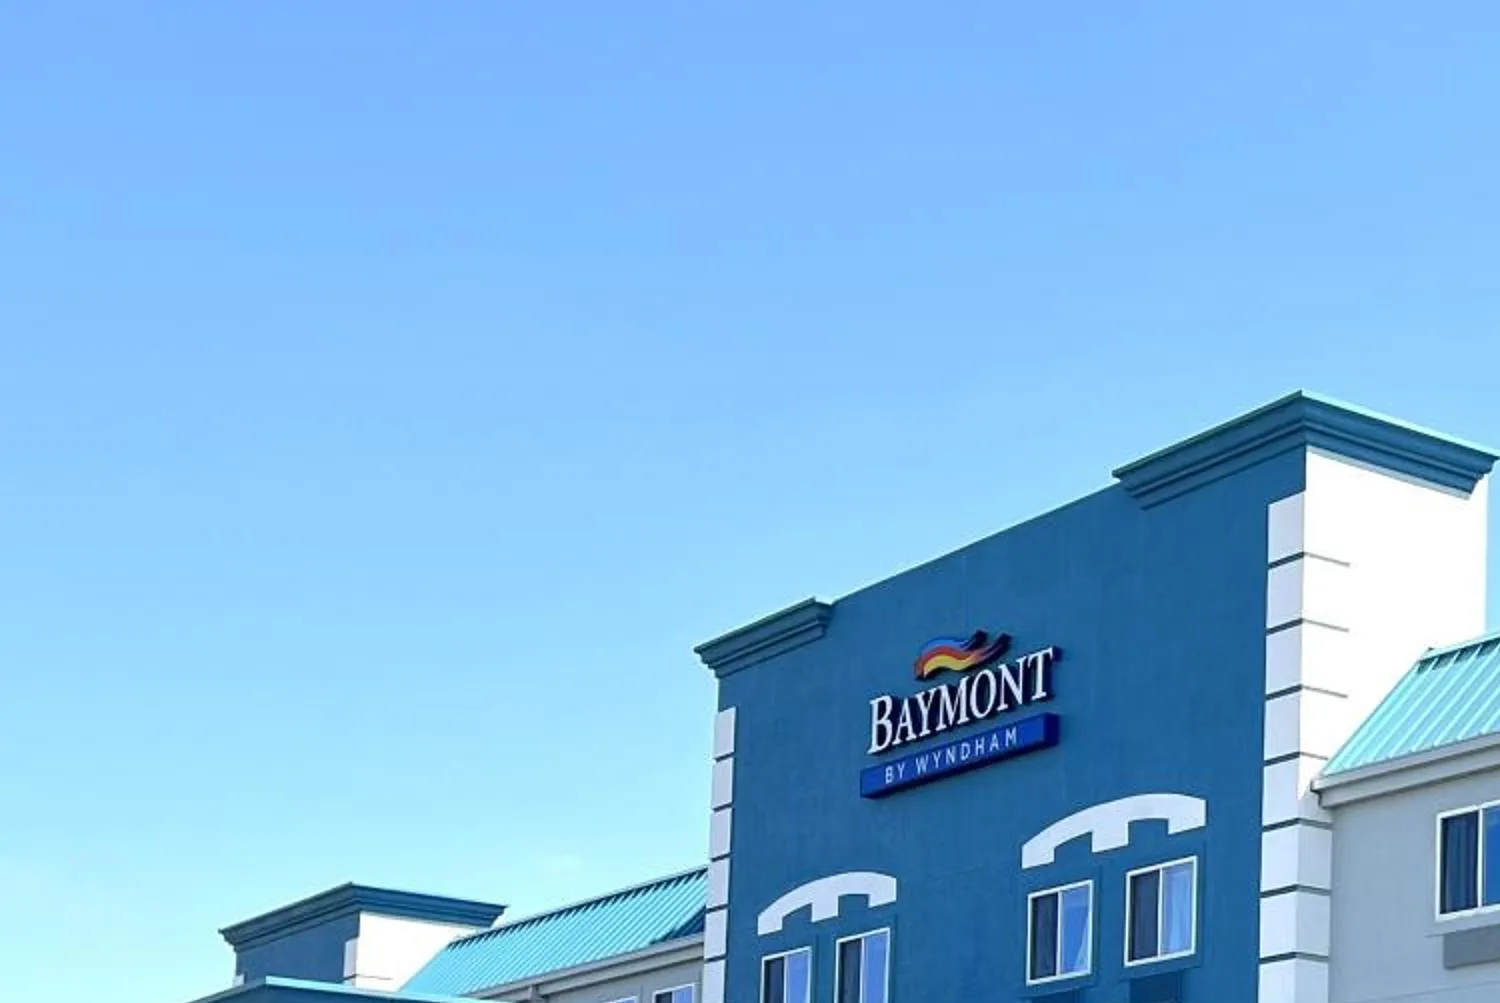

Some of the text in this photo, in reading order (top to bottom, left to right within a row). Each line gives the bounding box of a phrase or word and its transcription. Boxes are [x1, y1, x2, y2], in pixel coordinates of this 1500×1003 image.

[867, 647, 1054, 755] BAYMONT
[884, 726, 1019, 785] BY WYNDHAM
